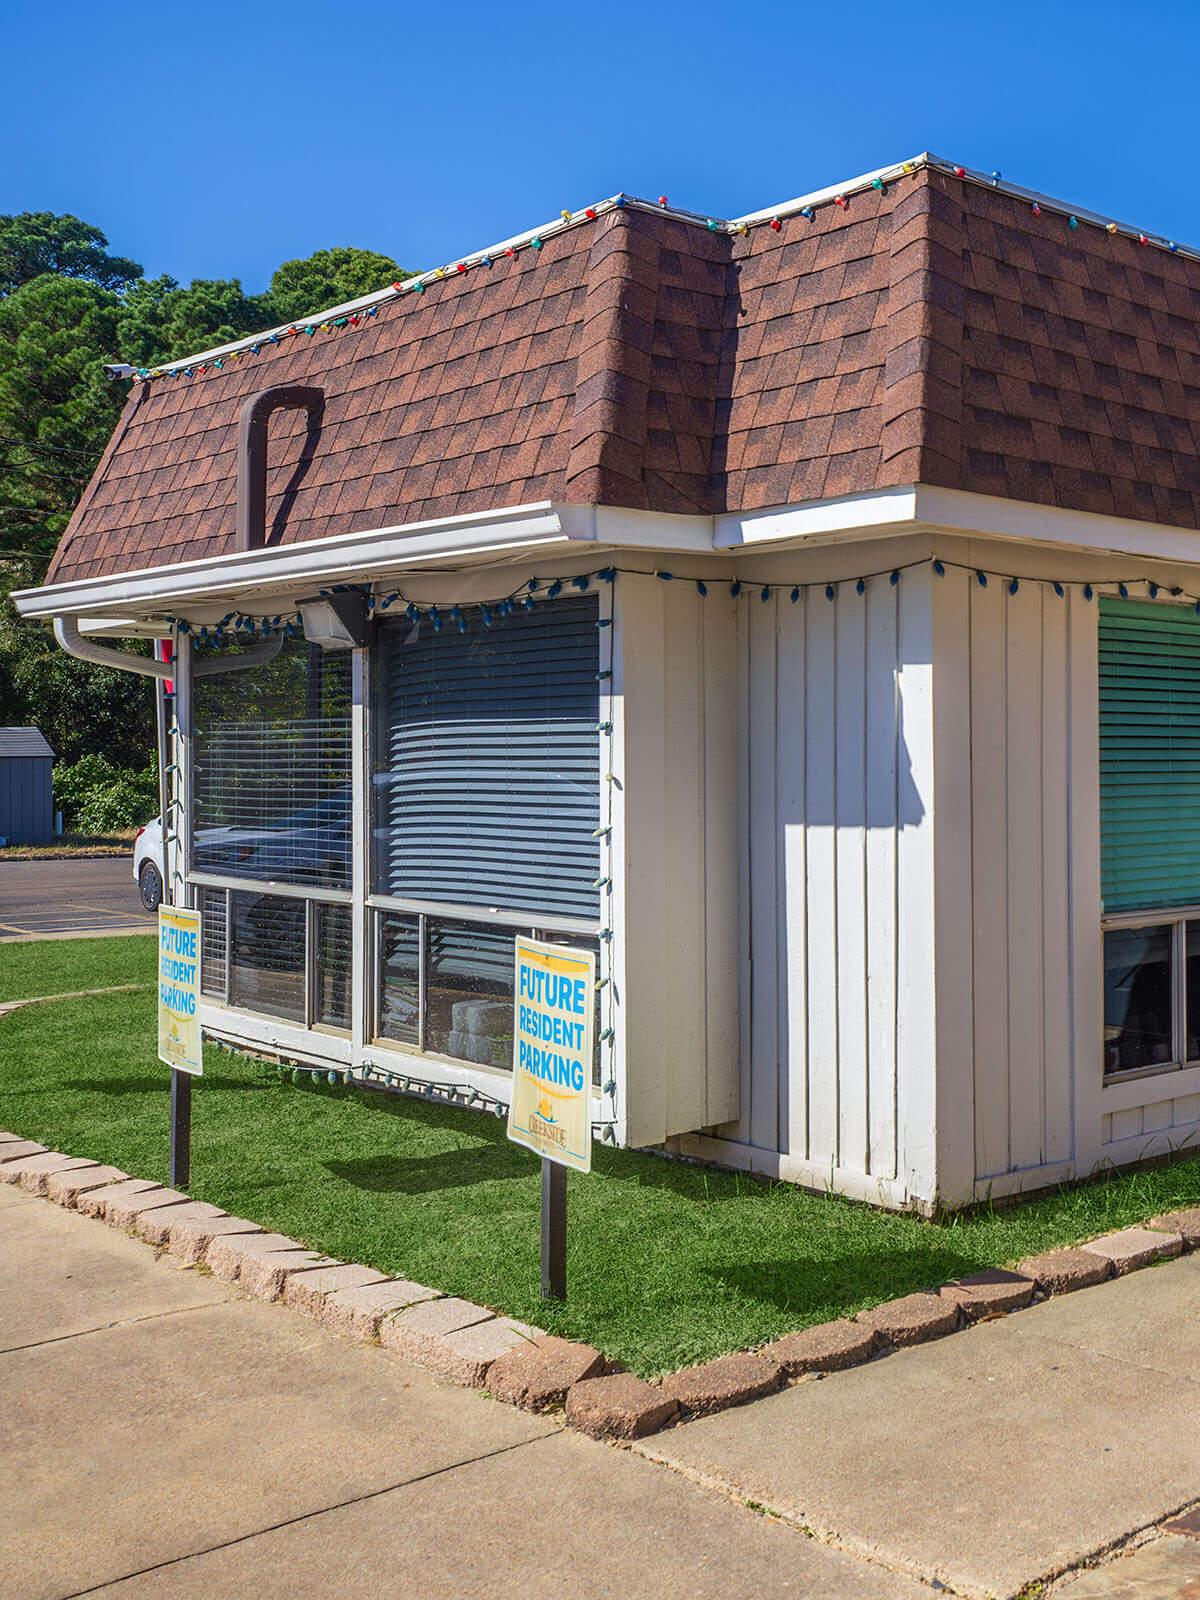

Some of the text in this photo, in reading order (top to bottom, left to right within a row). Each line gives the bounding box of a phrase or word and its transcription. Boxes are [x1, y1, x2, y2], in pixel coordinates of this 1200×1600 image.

[160, 926, 196, 957] FUTURE
[160, 956, 196, 985] RESIDENT
[519, 964, 586, 1014] FUTURE
[160, 984, 196, 1015] PARKING
[519, 1005, 584, 1050] RESIDENT
[519, 1040, 583, 1091] PARKING
